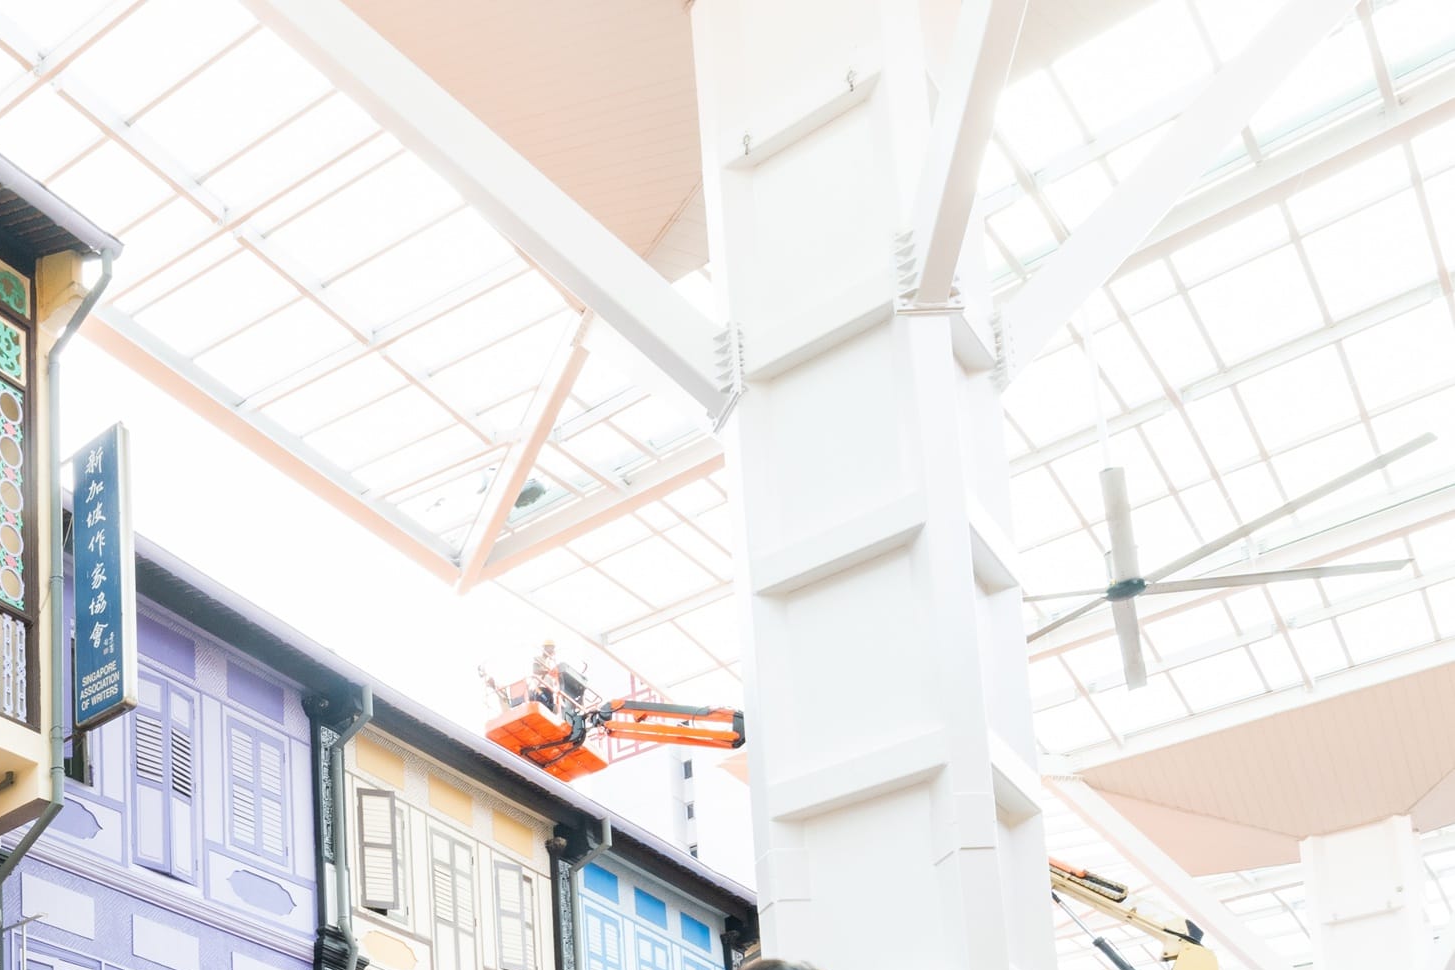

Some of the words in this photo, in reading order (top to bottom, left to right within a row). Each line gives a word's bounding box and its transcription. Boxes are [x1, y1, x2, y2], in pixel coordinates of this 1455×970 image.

[79, 673, 120, 702] ASSOCIATION
[81, 660, 117, 688] SINGAPORE
[81, 699, 91, 712] OF
[91, 686, 119, 707] WRITERS
